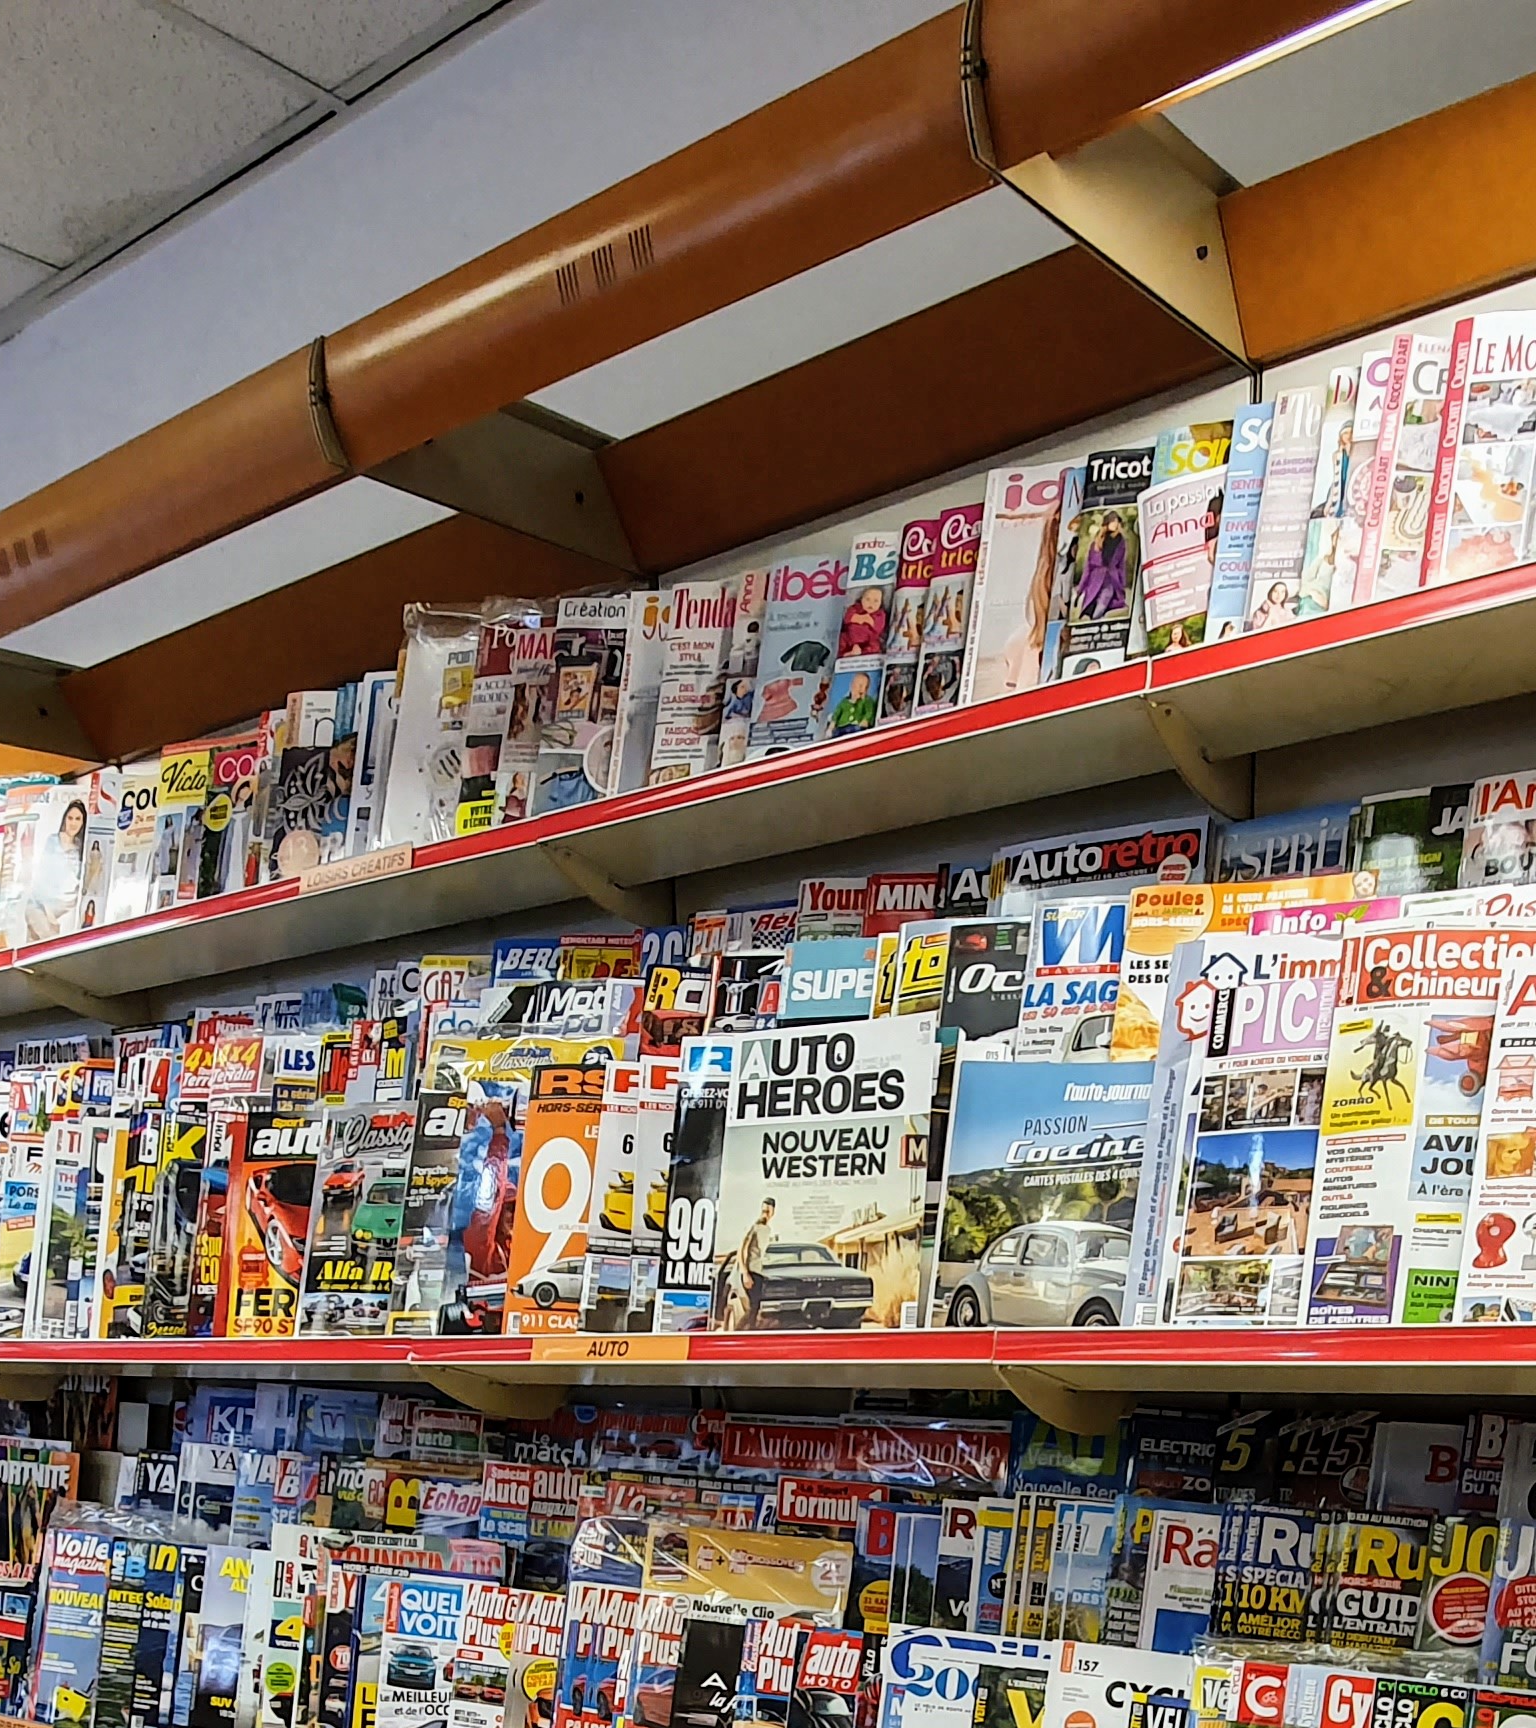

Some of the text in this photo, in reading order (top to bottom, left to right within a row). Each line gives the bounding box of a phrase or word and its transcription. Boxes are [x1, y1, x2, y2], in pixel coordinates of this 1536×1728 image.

[1088, 454, 1152, 483] Tricot
[1150, 510, 1216, 545] Anna
[564, 600, 627, 620] Création
[1009, 830, 1198, 884] Autoretro
[1134, 890, 1204, 909] Poules
[1271, 913, 1327, 936] Info
[1211, 987, 1231, 1051] COMMERCE
[284, 1047, 316, 1072] LES
[739, 1032, 856, 1079] AUTO
[735, 1068, 906, 1120] HEROES
[1332, 1096, 1375, 1107] ZORRO
[1023, 1116, 1089, 1137] PASSION
[761, 1126, 891, 1154] NOUVEAU
[761, 1152, 887, 1180] WESTERN
[521, 1312, 545, 1329] 911
[587, 1340, 629, 1358] AUTO
[54, 1532, 110, 1561] Voile
[692, 1597, 776, 1621] Nouvelle Clio
[804, 1641, 862, 1678] auto
[1076, 1659, 1100, 1673] 157
[803, 1674, 853, 1690] MOTO
